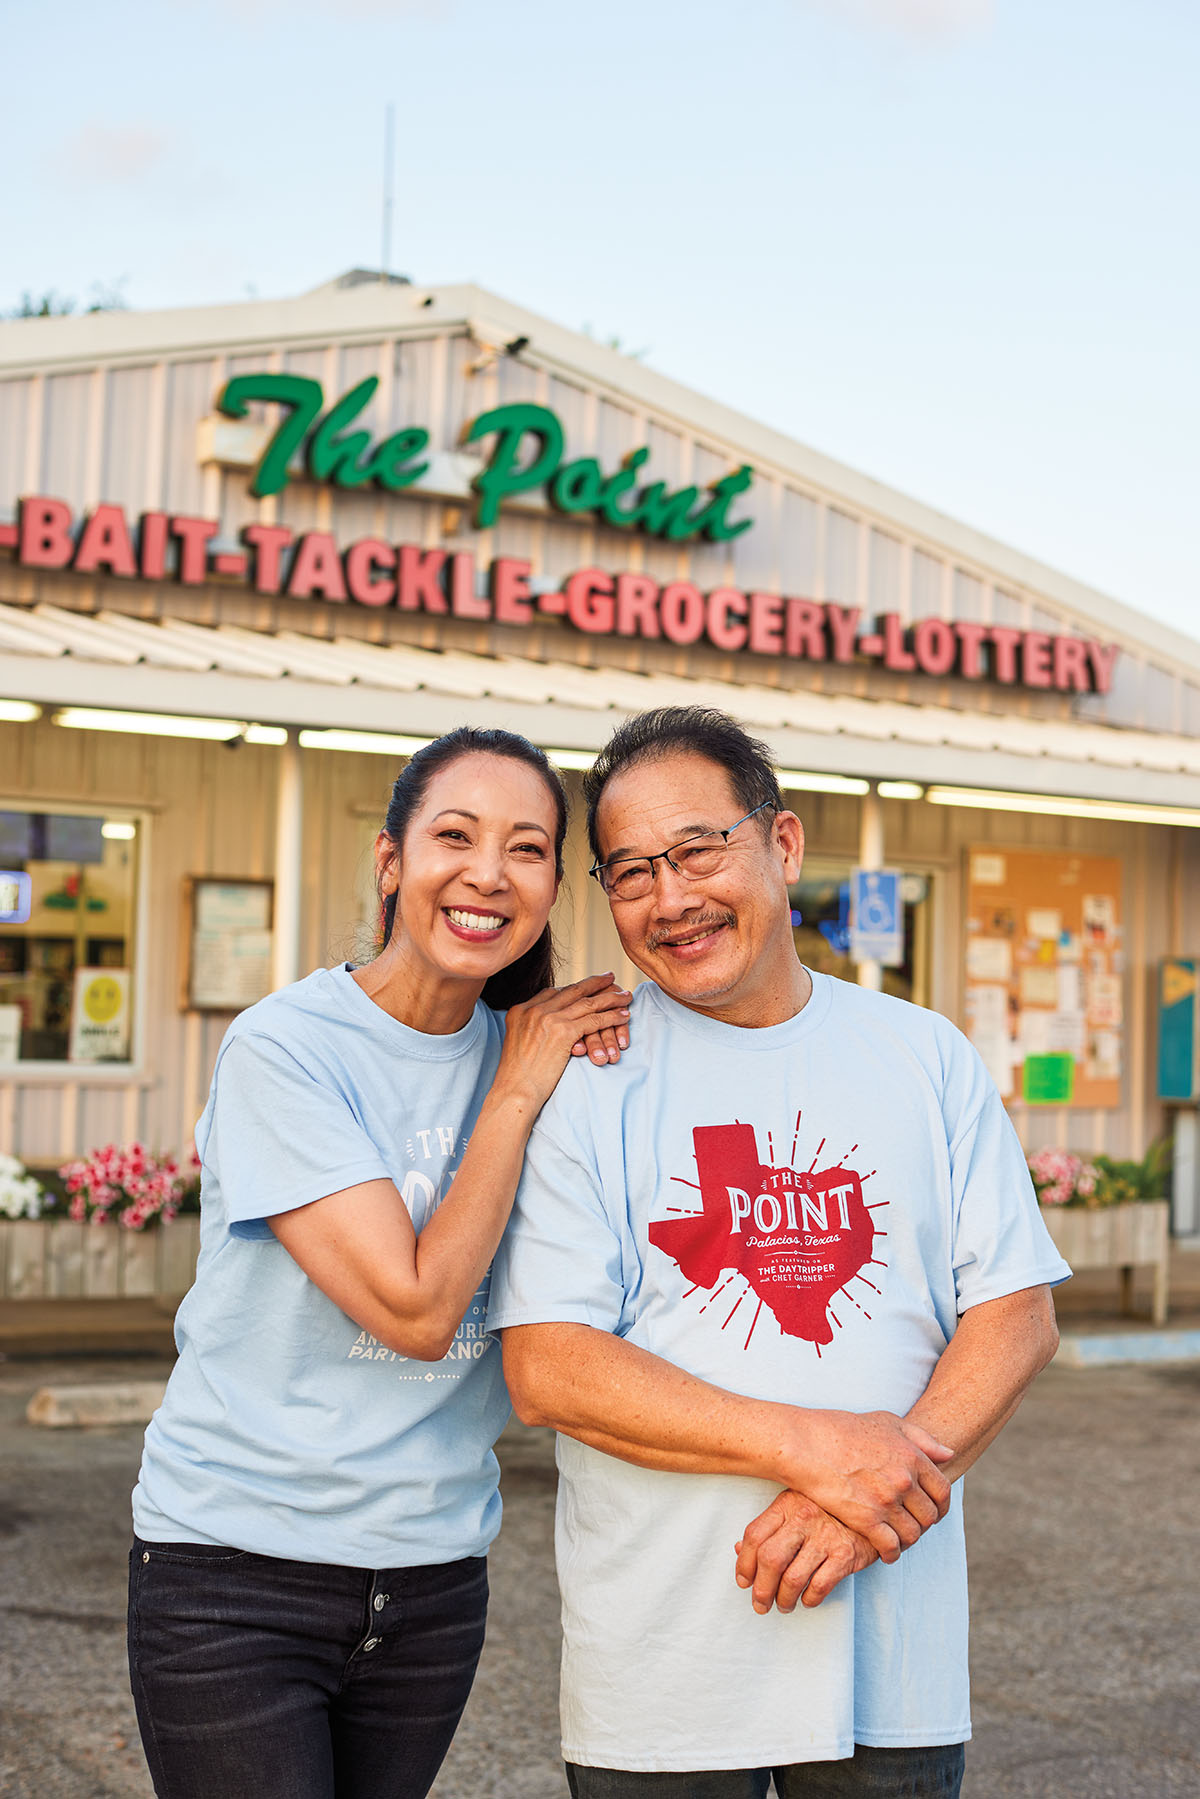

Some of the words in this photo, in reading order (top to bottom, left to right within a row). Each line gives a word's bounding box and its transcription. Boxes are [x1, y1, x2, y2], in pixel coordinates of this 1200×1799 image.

[219, 373, 430, 497] The
[467, 403, 753, 541] Point
[416, 1127, 457, 1159] TH
[769, 1171, 803, 1189] THE
[725, 1183, 854, 1235] POINT
[745, 1234, 803, 1248] Palacios,
[804, 1233, 842, 1246] Texas
[757, 1265, 777, 1276] THE
[778, 1263, 836, 1275] DAYTRIPPER
[772, 1274, 792, 1282] CHET
[794, 1274, 824, 1282] GARNER
